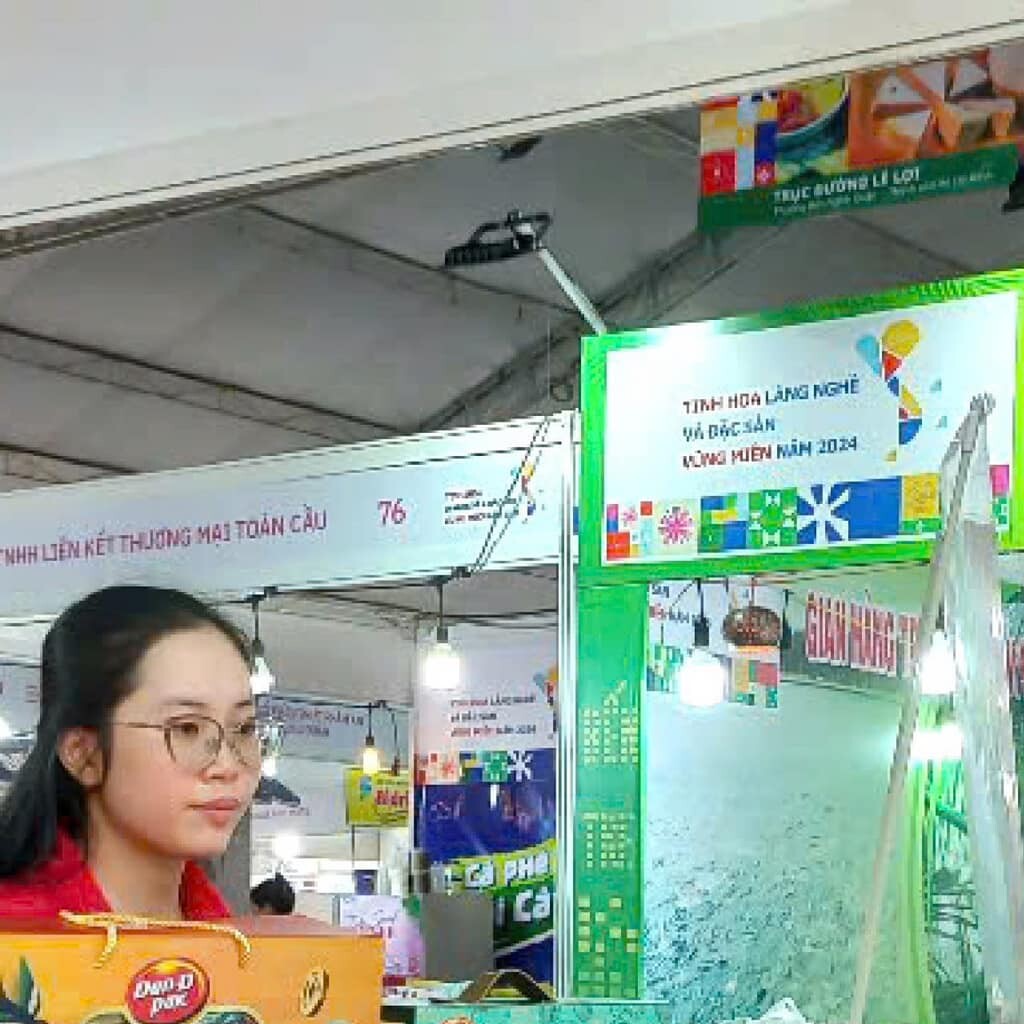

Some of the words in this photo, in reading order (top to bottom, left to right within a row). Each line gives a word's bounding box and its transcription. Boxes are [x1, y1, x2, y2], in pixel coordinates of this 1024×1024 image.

[727, 391, 761, 409] HOA
[816, 435, 858, 455] 2024
[377, 500, 407, 526] 76
